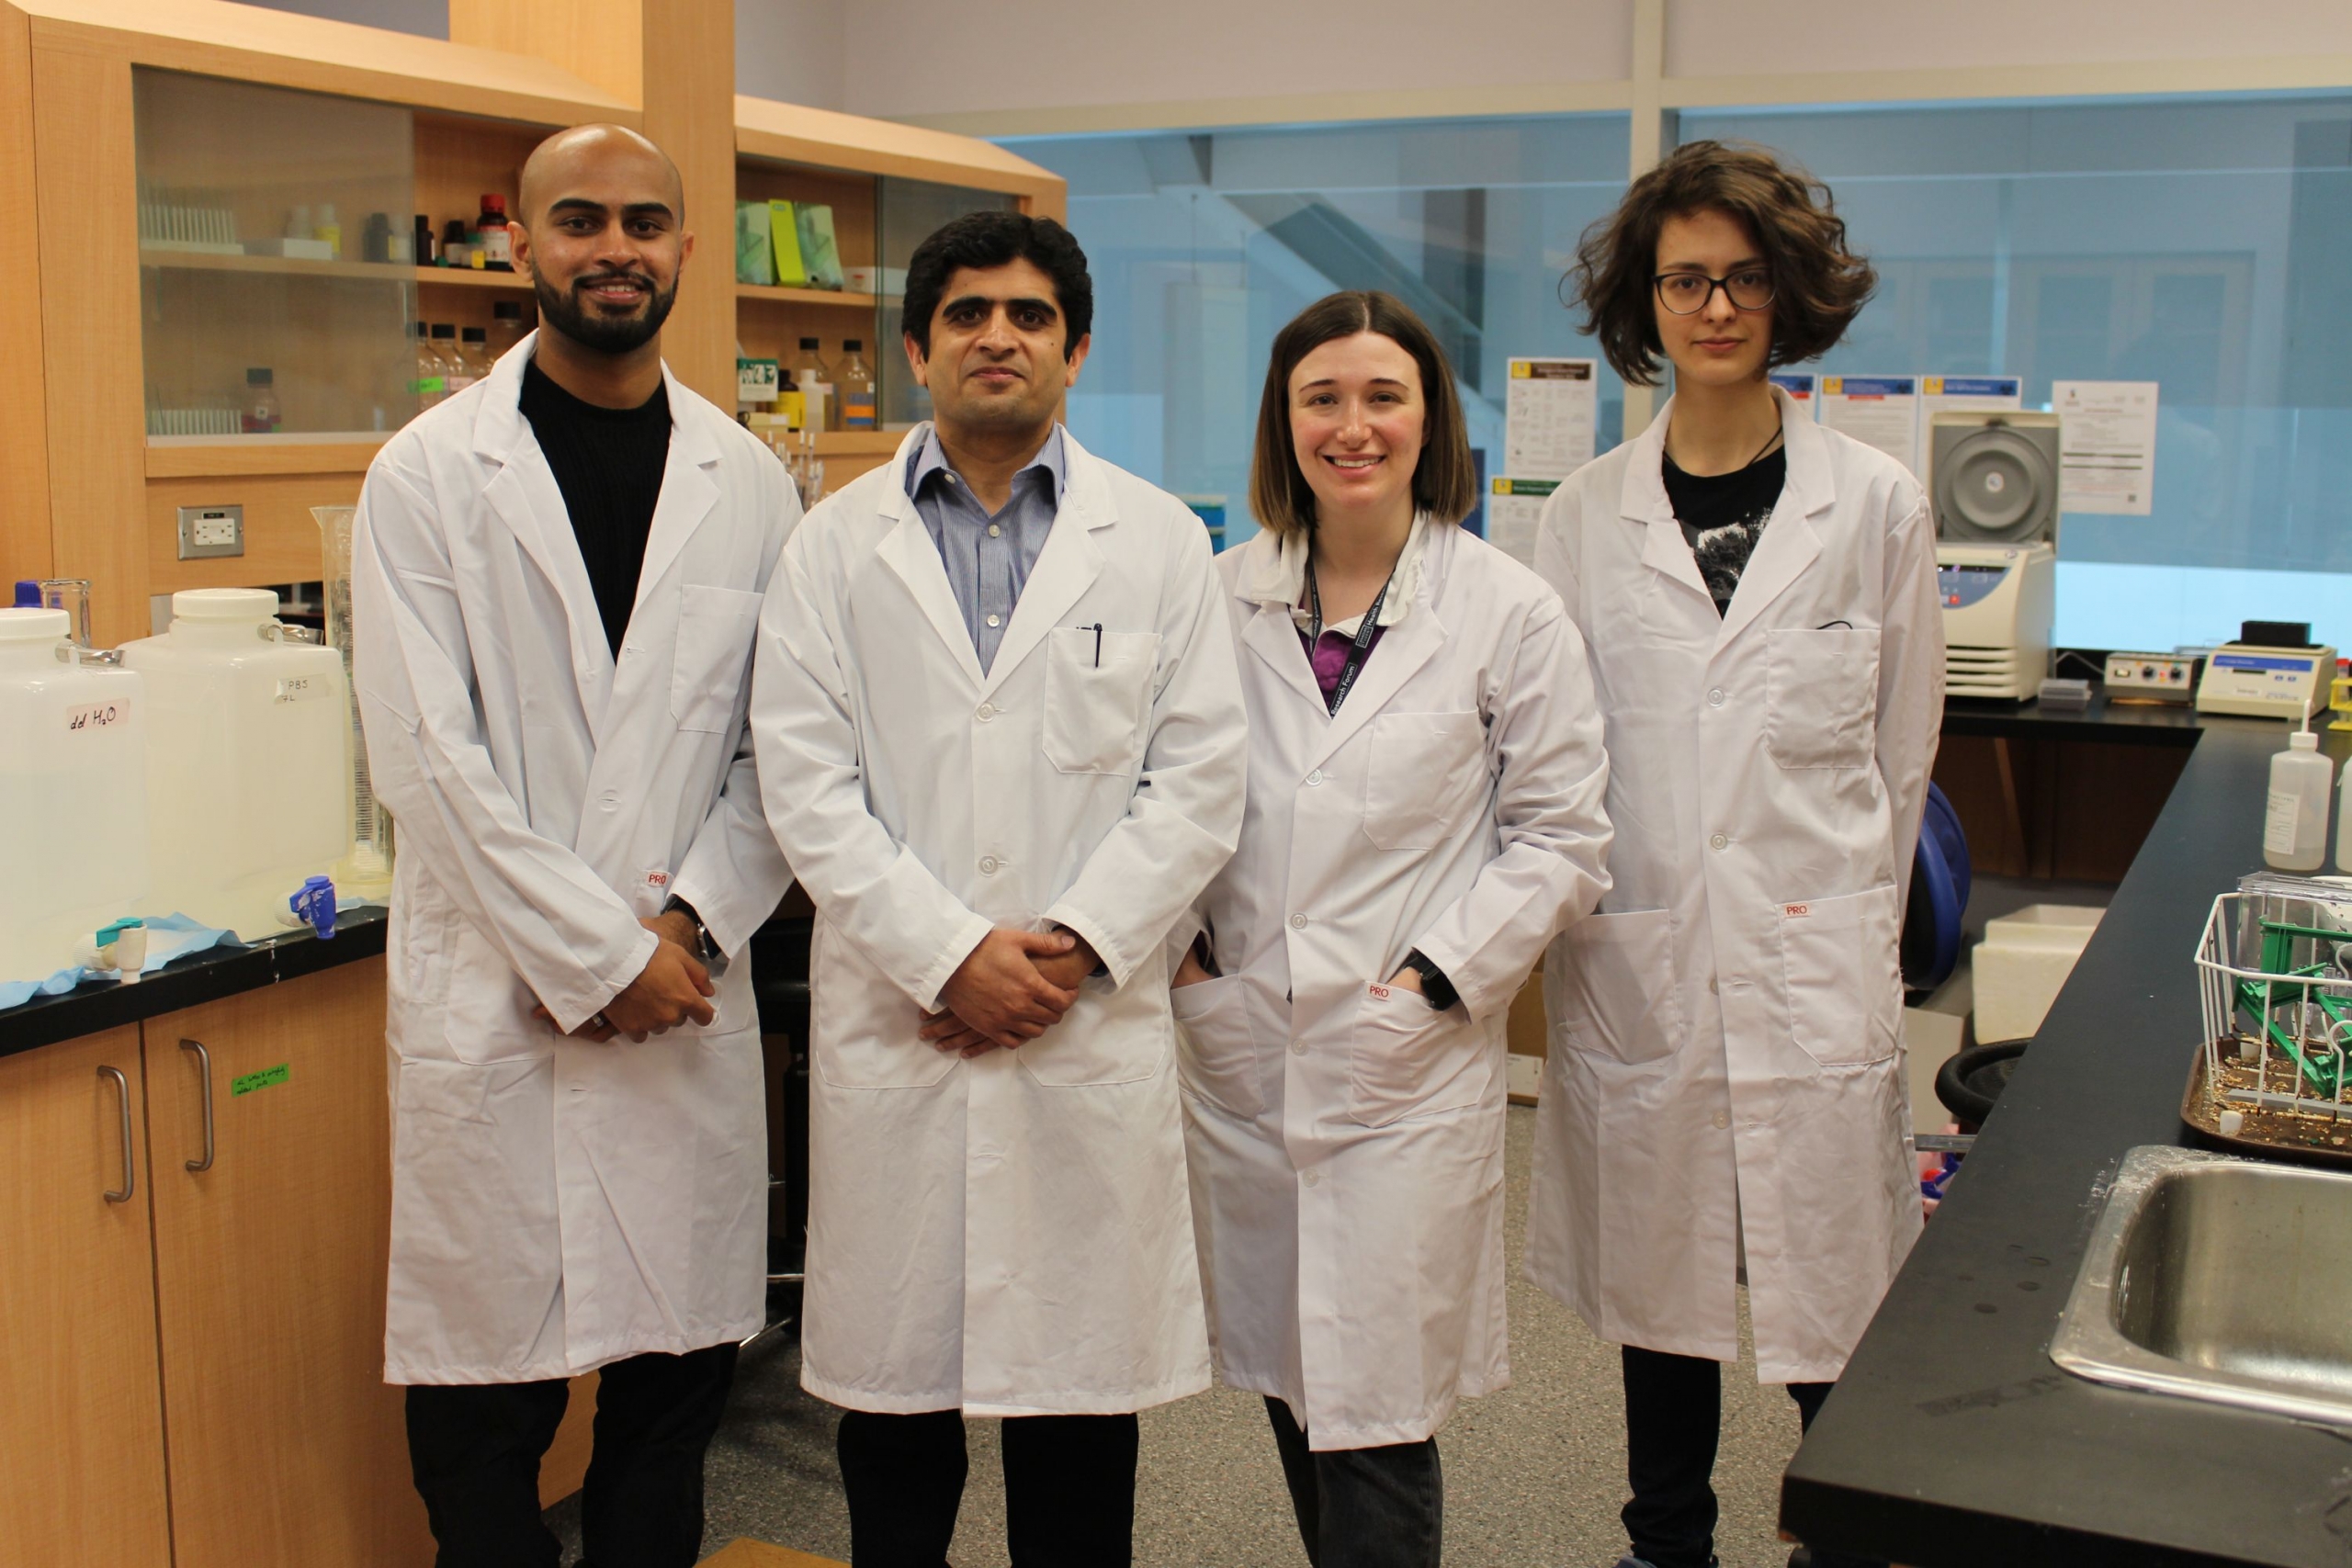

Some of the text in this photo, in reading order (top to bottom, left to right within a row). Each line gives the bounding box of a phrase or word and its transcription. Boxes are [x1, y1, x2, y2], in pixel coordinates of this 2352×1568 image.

[288, 680, 308, 690] PBS
[1330, 666, 1355, 715] Research Forum
[71, 713, 87, 729] dd
[649, 874, 667, 885] PRO
[1786, 905, 1807, 915] PRO
[1370, 986, 1389, 998] PRO
